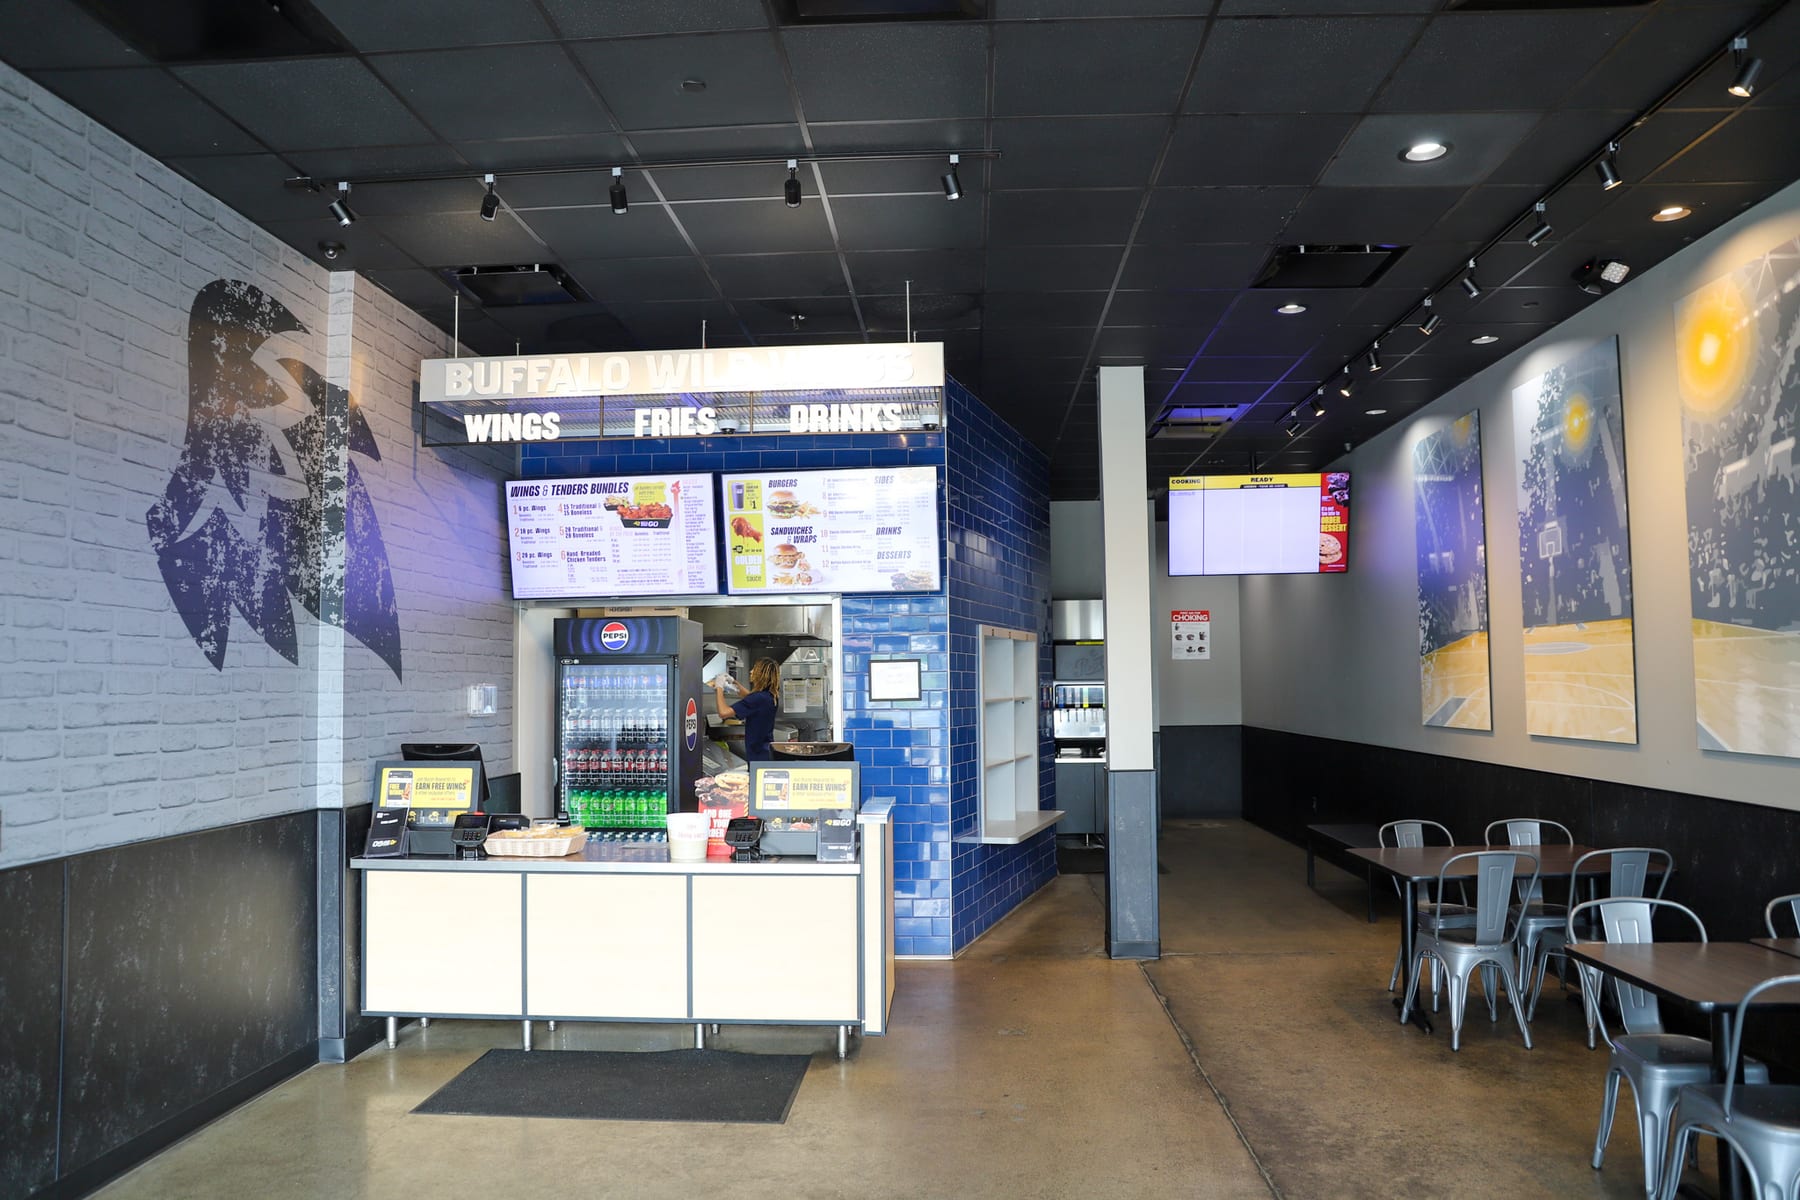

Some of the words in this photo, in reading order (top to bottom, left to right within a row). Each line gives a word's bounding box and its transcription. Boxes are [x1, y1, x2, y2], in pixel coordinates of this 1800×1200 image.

[444, 356, 631, 397] BUFFALO
[464, 412, 561, 442] WINGS
[634, 407, 716, 438] FRIES
[790, 402, 902, 433] DRINKS
[768, 478, 798, 488] BURGERS
[874, 475, 895, 485] SIDES
[510, 485, 541, 498] WINGS
[542, 484, 549, 496] &
[551, 483, 588, 496] TENDERS
[590, 482, 629, 495] BUNDLES
[513, 506, 518, 515] 1
[531, 504, 547, 512] Wings
[514, 528, 519, 537] 2
[771, 526, 814, 536] SANDWICHES
[876, 526, 902, 536] DRINKS
[793, 535, 817, 544] WRAPS
[516, 552, 521, 561] 3
[877, 550, 912, 560] DESSERTS
[603, 632, 627, 640] PEPSI
[686, 719, 697, 730] PEPSI
[415, 782, 430, 790] EARN
[432, 782, 445, 790] FREE
[446, 782, 466, 790] WINGS
[793, 783, 809, 791] EARN
[810, 783, 824, 791] FREE
[825, 782, 847, 791] WINGS
[703, 809, 716, 819] ADD
[718, 809, 732, 819] ONE
